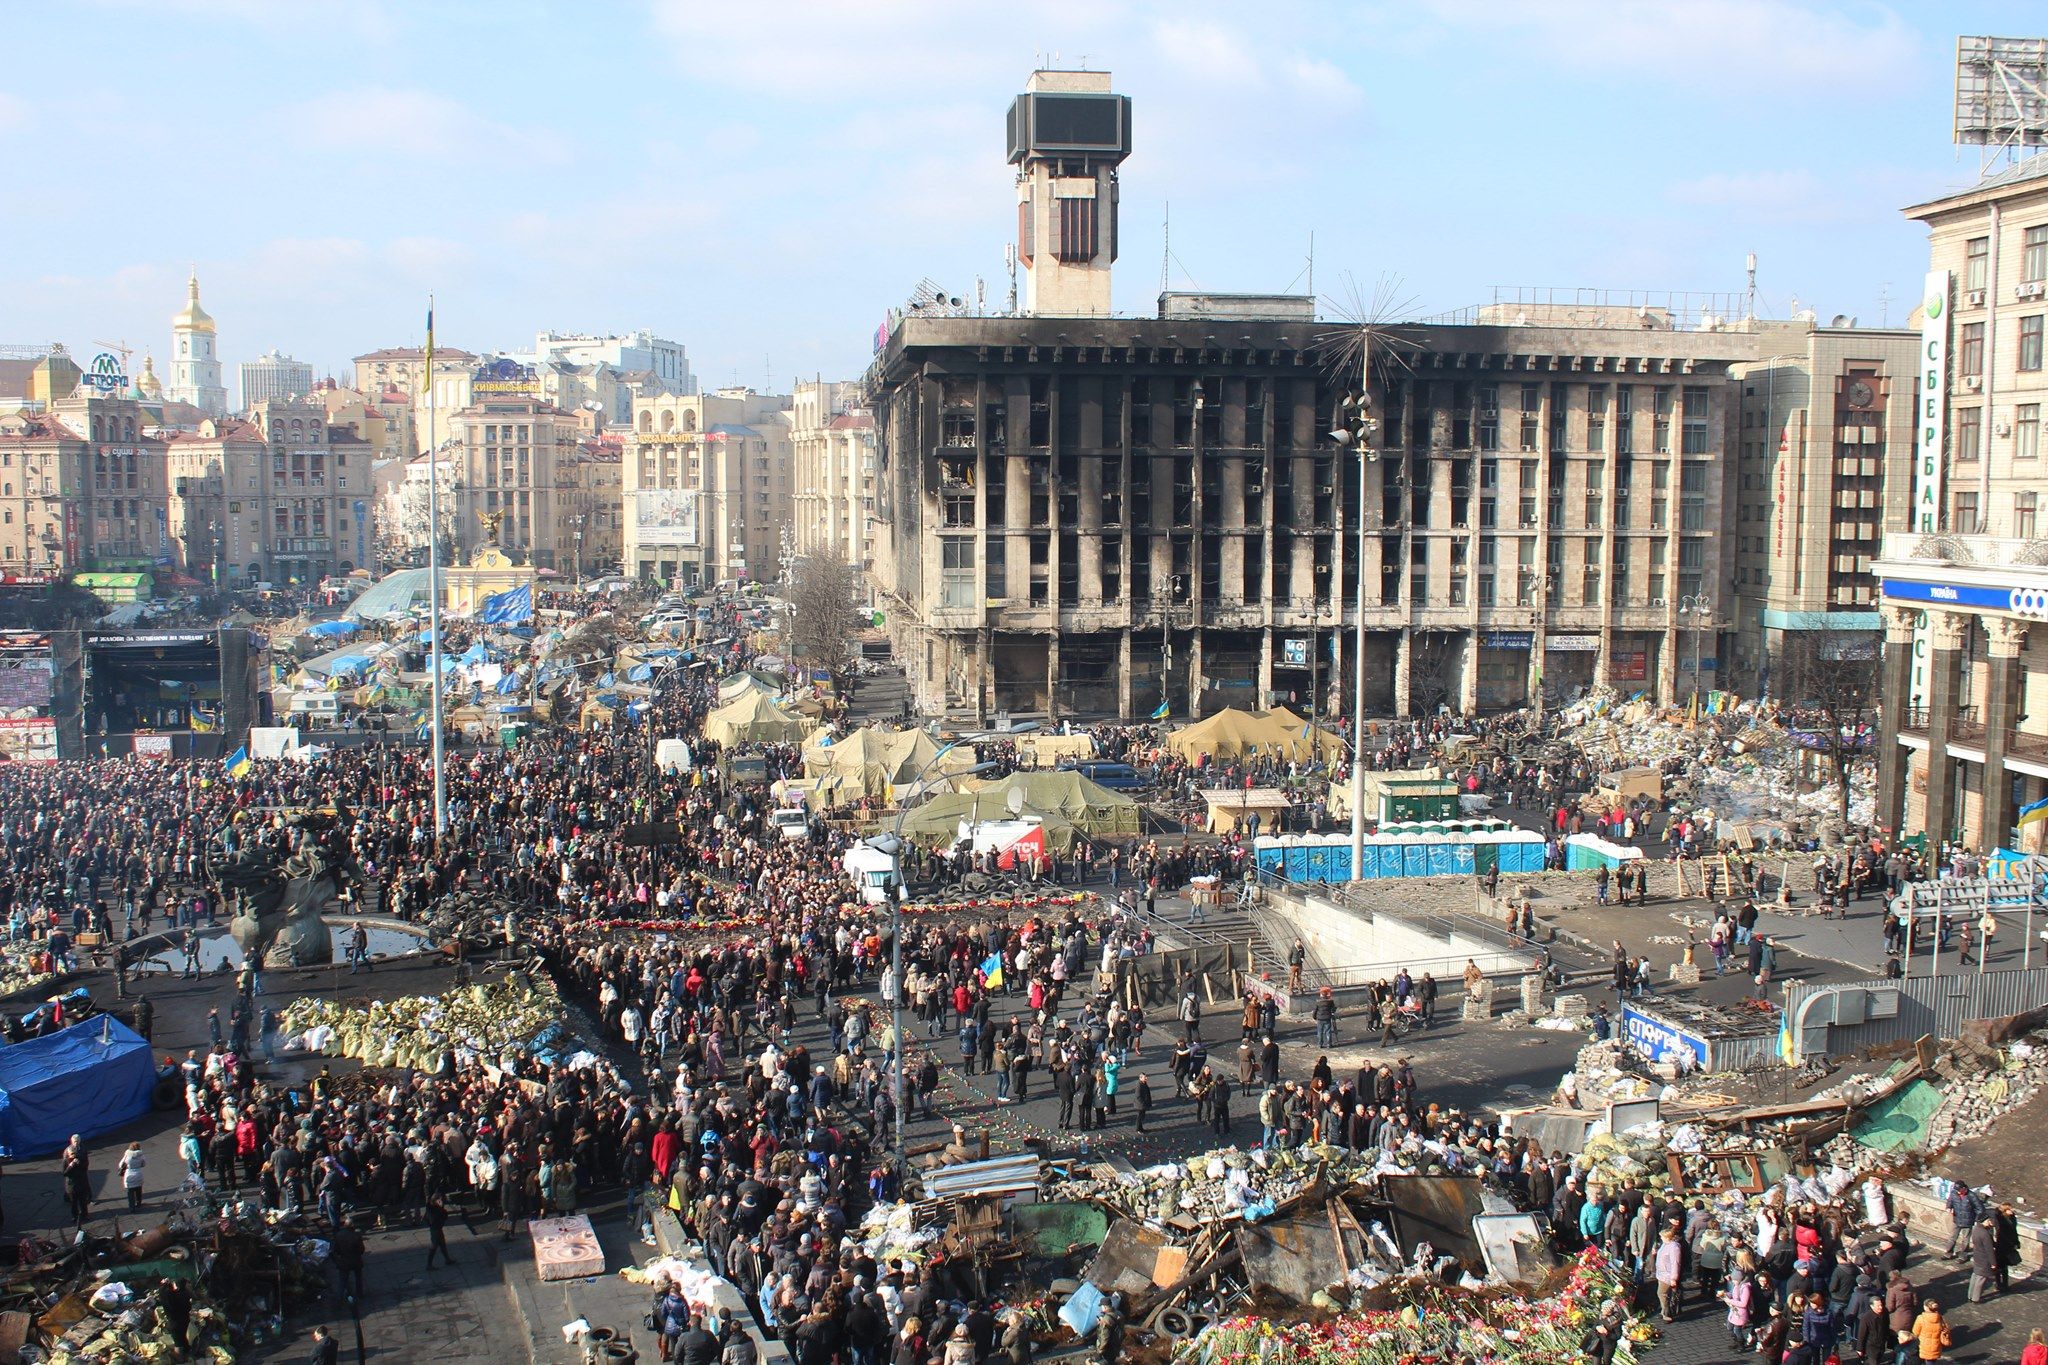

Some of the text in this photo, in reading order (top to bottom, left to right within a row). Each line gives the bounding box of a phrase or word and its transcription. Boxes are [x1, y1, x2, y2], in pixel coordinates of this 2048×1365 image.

[81, 373, 130, 387] МЕТРОБУД
[1921, 340, 1938, 533] СБЕРБАН
[1930, 587, 1958, 600] УКРАЇНА
[1286, 652, 1304, 662] YO
[1629, 1017, 1671, 1050] СПОРТ
